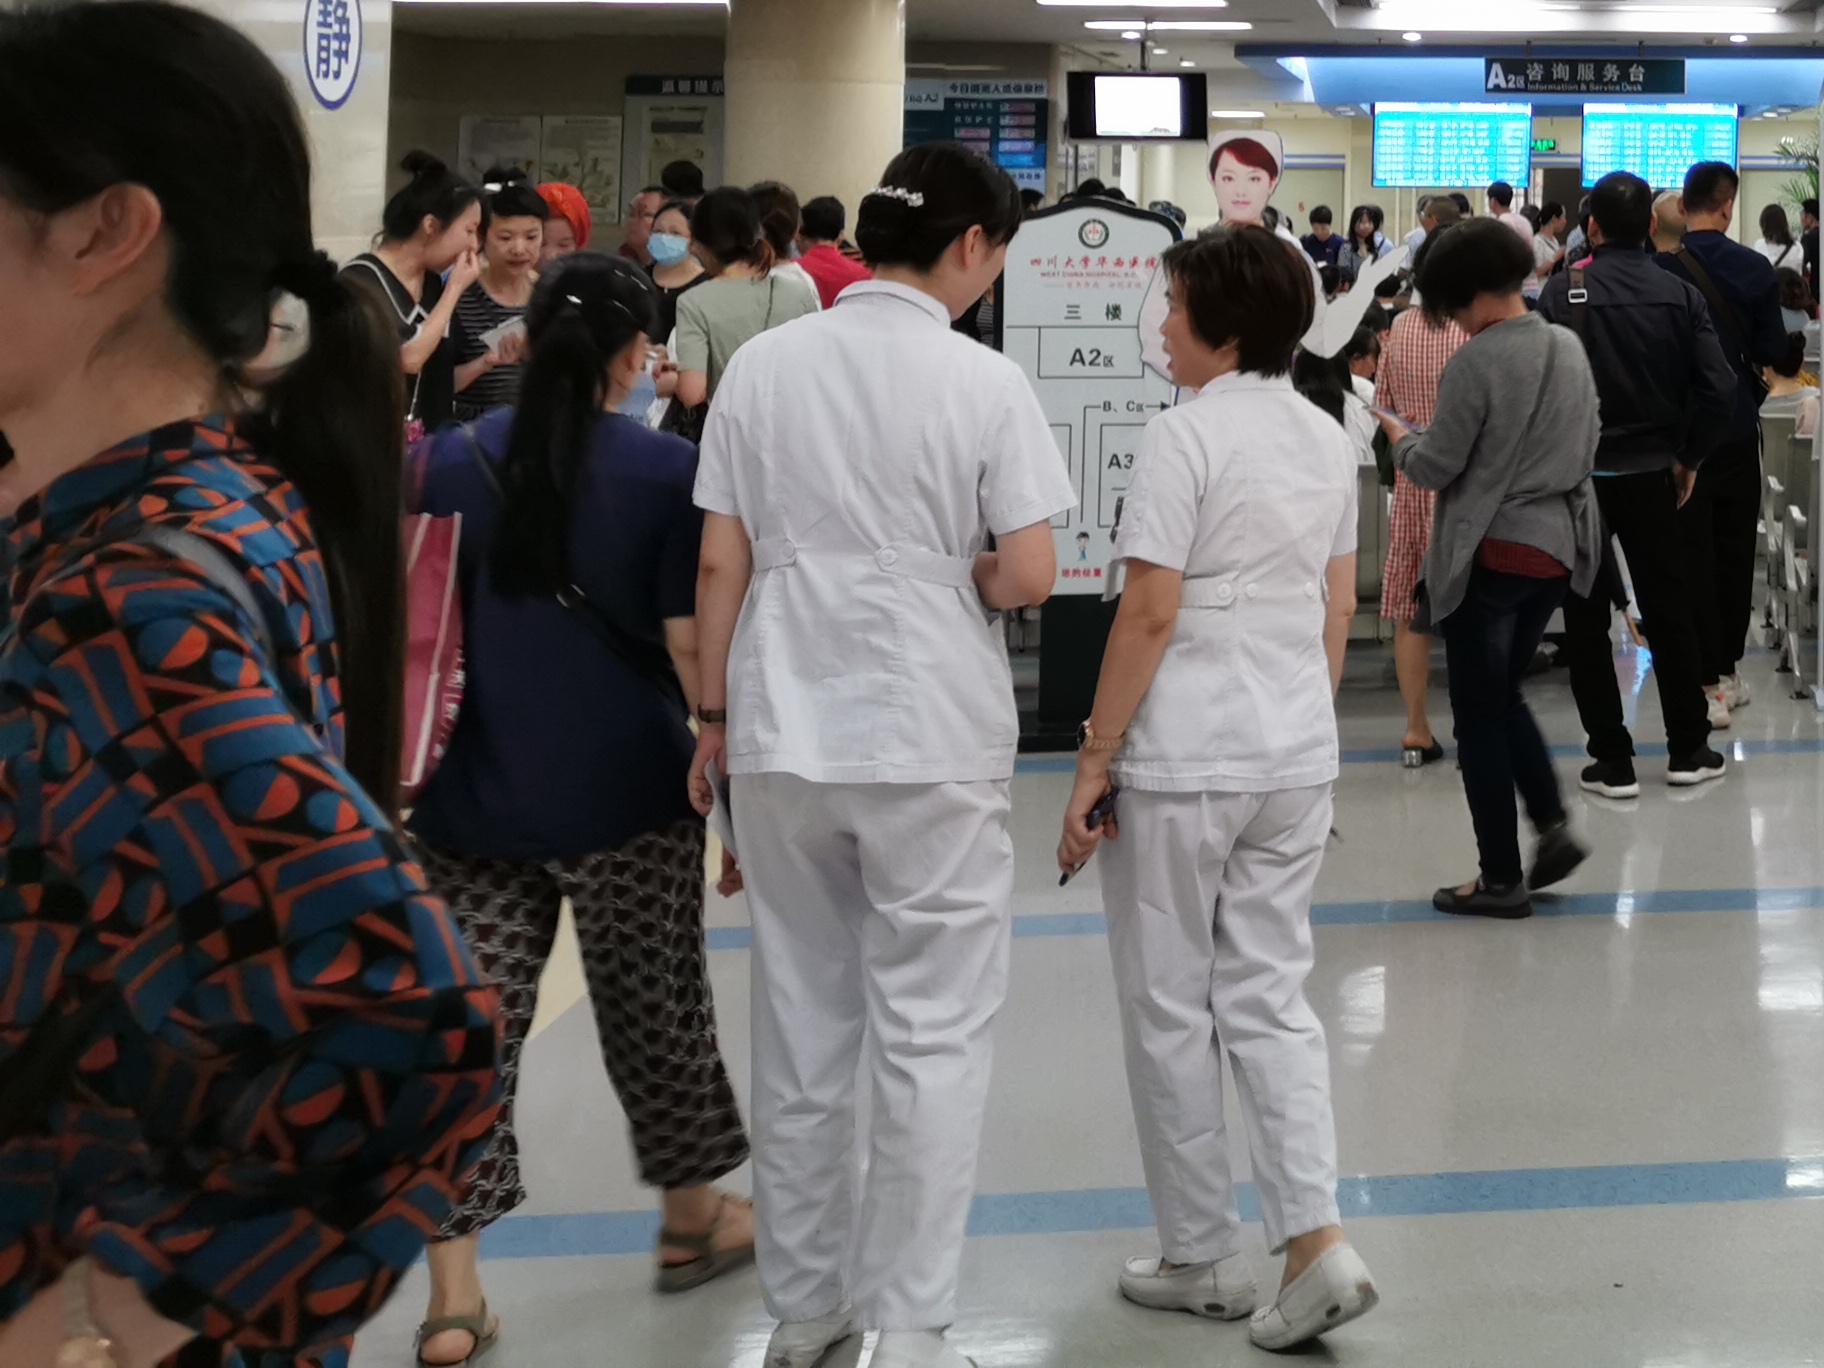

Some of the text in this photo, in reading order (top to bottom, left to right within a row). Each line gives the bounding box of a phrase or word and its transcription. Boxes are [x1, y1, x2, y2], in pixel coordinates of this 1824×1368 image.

[1526, 62, 1645, 82] 咨询服务台
[1527, 83, 1578, 92] Information
[1589, 83, 1620, 92] Service
[1621, 82, 1642, 92] Desk
[1069, 348, 1114, 367] A2区
